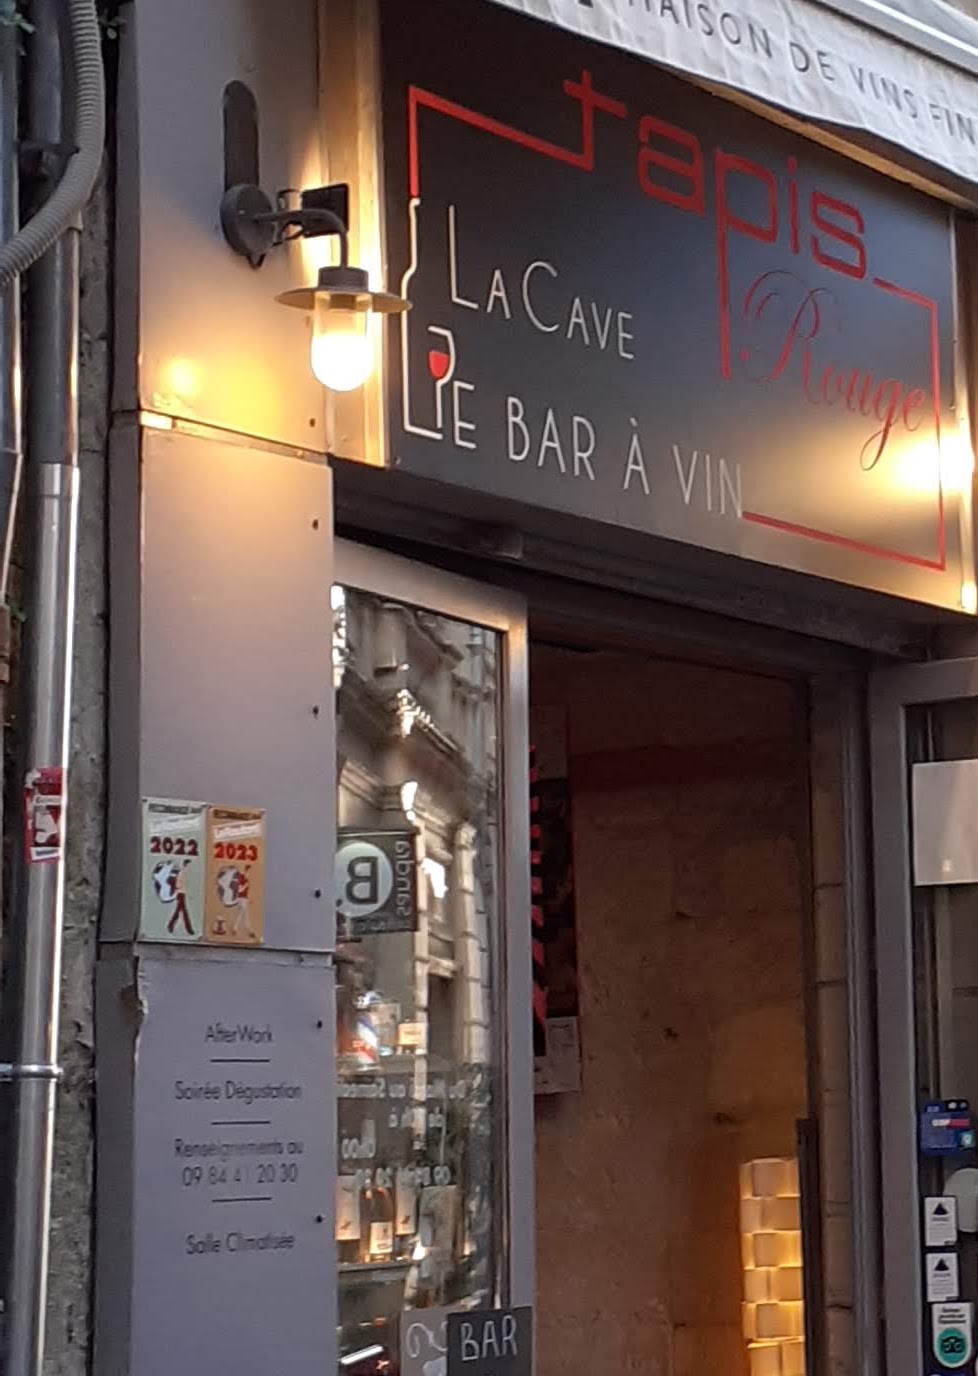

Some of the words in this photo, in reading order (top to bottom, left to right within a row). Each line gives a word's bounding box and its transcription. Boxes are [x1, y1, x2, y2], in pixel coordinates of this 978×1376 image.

[789, 41, 835, 82] DE
[851, 65, 919, 119] VINS
[738, 269, 926, 472] Rouge
[506, 395, 596, 481] BAR
[672, 444, 744, 518] VIN
[150, 835, 199, 857] 2022
[214, 842, 259, 862] 2023
[174, 1080, 220, 1100] Soirée
[226, 1079, 302, 1104] Dégustation
[174, 1138, 284, 1161] Renseignements
[287, 1140, 304, 1154] au
[182, 1165, 202, 1186] 09
[256, 1163, 276, 1183] 20
[279, 1162, 299, 1182] 30
[186, 1233, 221, 1255] Salle
[460, 1314, 519, 1362] BAR
